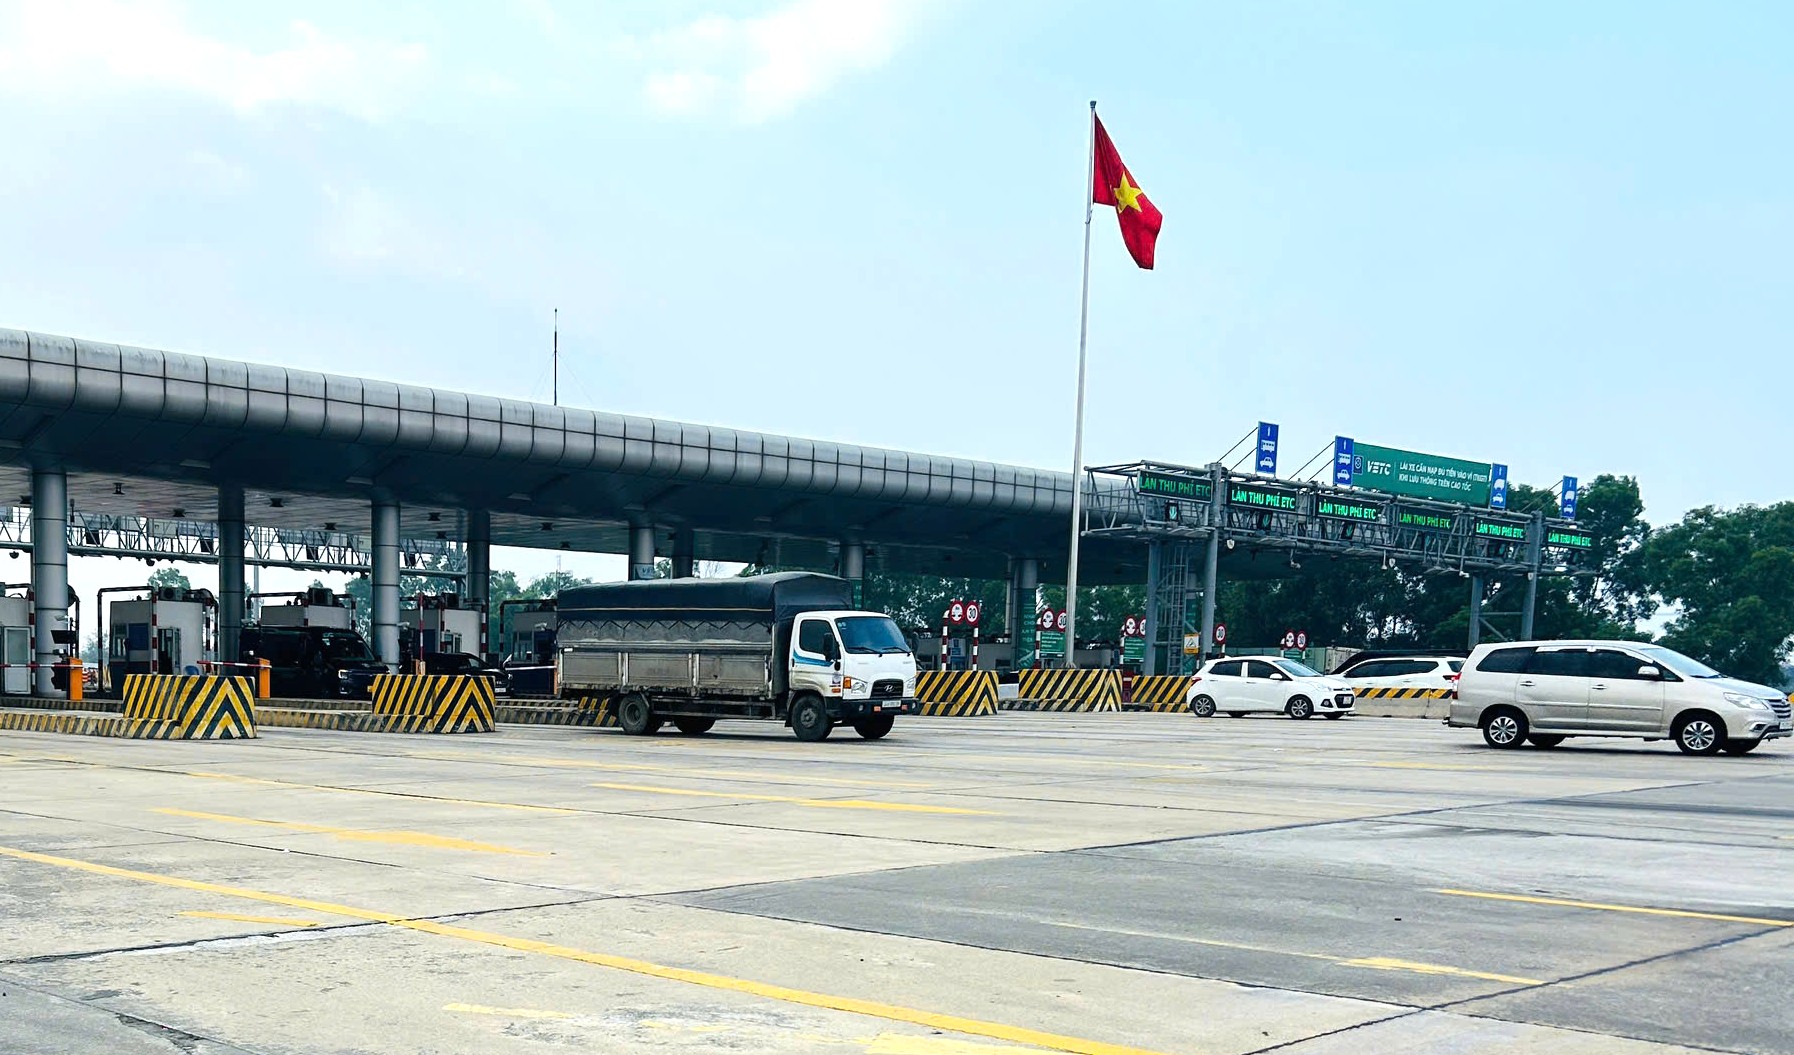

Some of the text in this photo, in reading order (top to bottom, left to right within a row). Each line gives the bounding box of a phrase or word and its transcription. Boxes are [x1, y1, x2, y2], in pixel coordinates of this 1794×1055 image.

[1367, 460, 1391, 475] VETC
[1408, 464, 1416, 472] XE
[1158, 480, 1176, 492] THU
[1195, 484, 1210, 497] ETC
[1450, 481, 1461, 490] CAO
[1249, 492, 1264, 505] THU
[1266, 492, 1280, 507] PHÍ
[1281, 496, 1295, 510] ETC
[1334, 504, 1348, 516] THU
[1350, 504, 1362, 517] PHÍ
[1364, 508, 1376, 520] ETC
[1413, 514, 1426, 525] THU
[1439, 518, 1450, 529] ETC
[1488, 524, 1500, 536] THU
[1513, 528, 1524, 538] ETC
[1560, 534, 1571, 544] THU
[1582, 537, 1592, 547] ETC
[968, 608, 976, 619] 30
